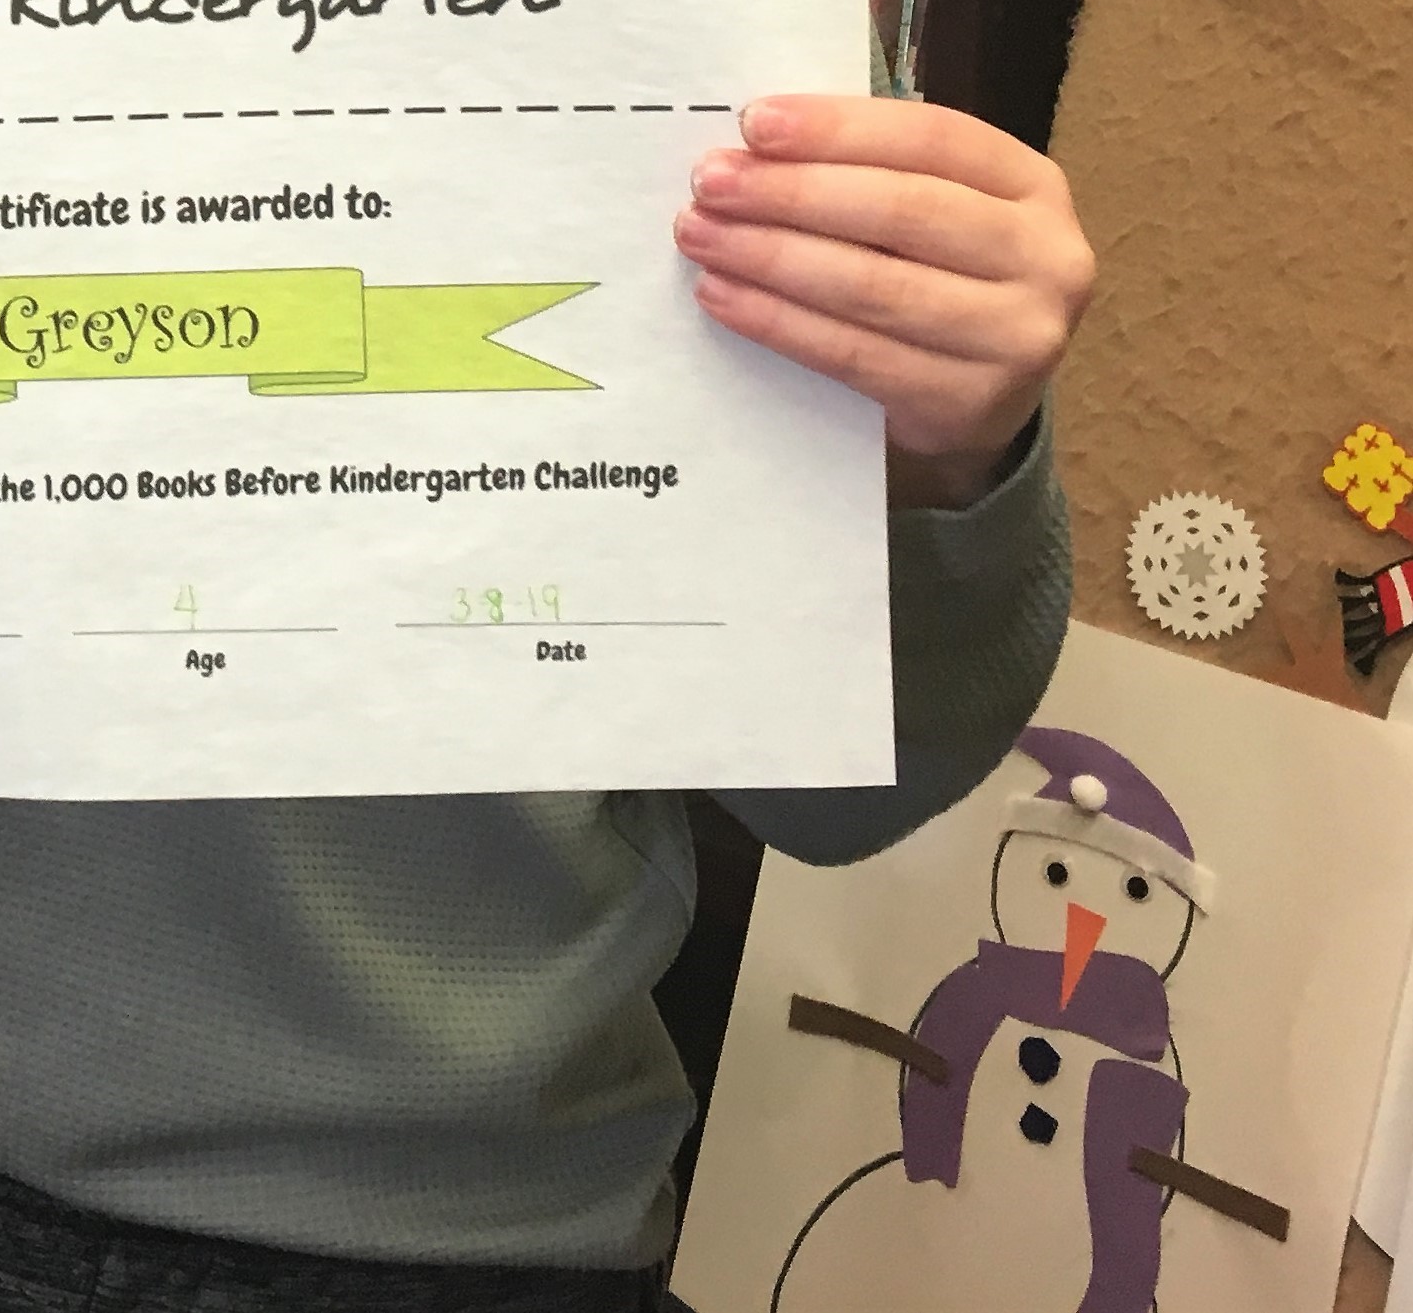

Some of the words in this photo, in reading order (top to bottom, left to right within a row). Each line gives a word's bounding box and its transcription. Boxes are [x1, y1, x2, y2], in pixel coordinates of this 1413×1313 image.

[141, 190, 166, 225] is
[175, 184, 335, 224] awarded
[344, 184, 392, 219] to:
[137, 470, 216, 500] Books
[225, 466, 321, 497] Before
[330, 462, 526, 503] Kindergarten
[534, 461, 680, 499] Challenge
[173, 585, 200, 631] 4
[185, 649, 227, 678] Age
[536, 640, 587, 663] Date
